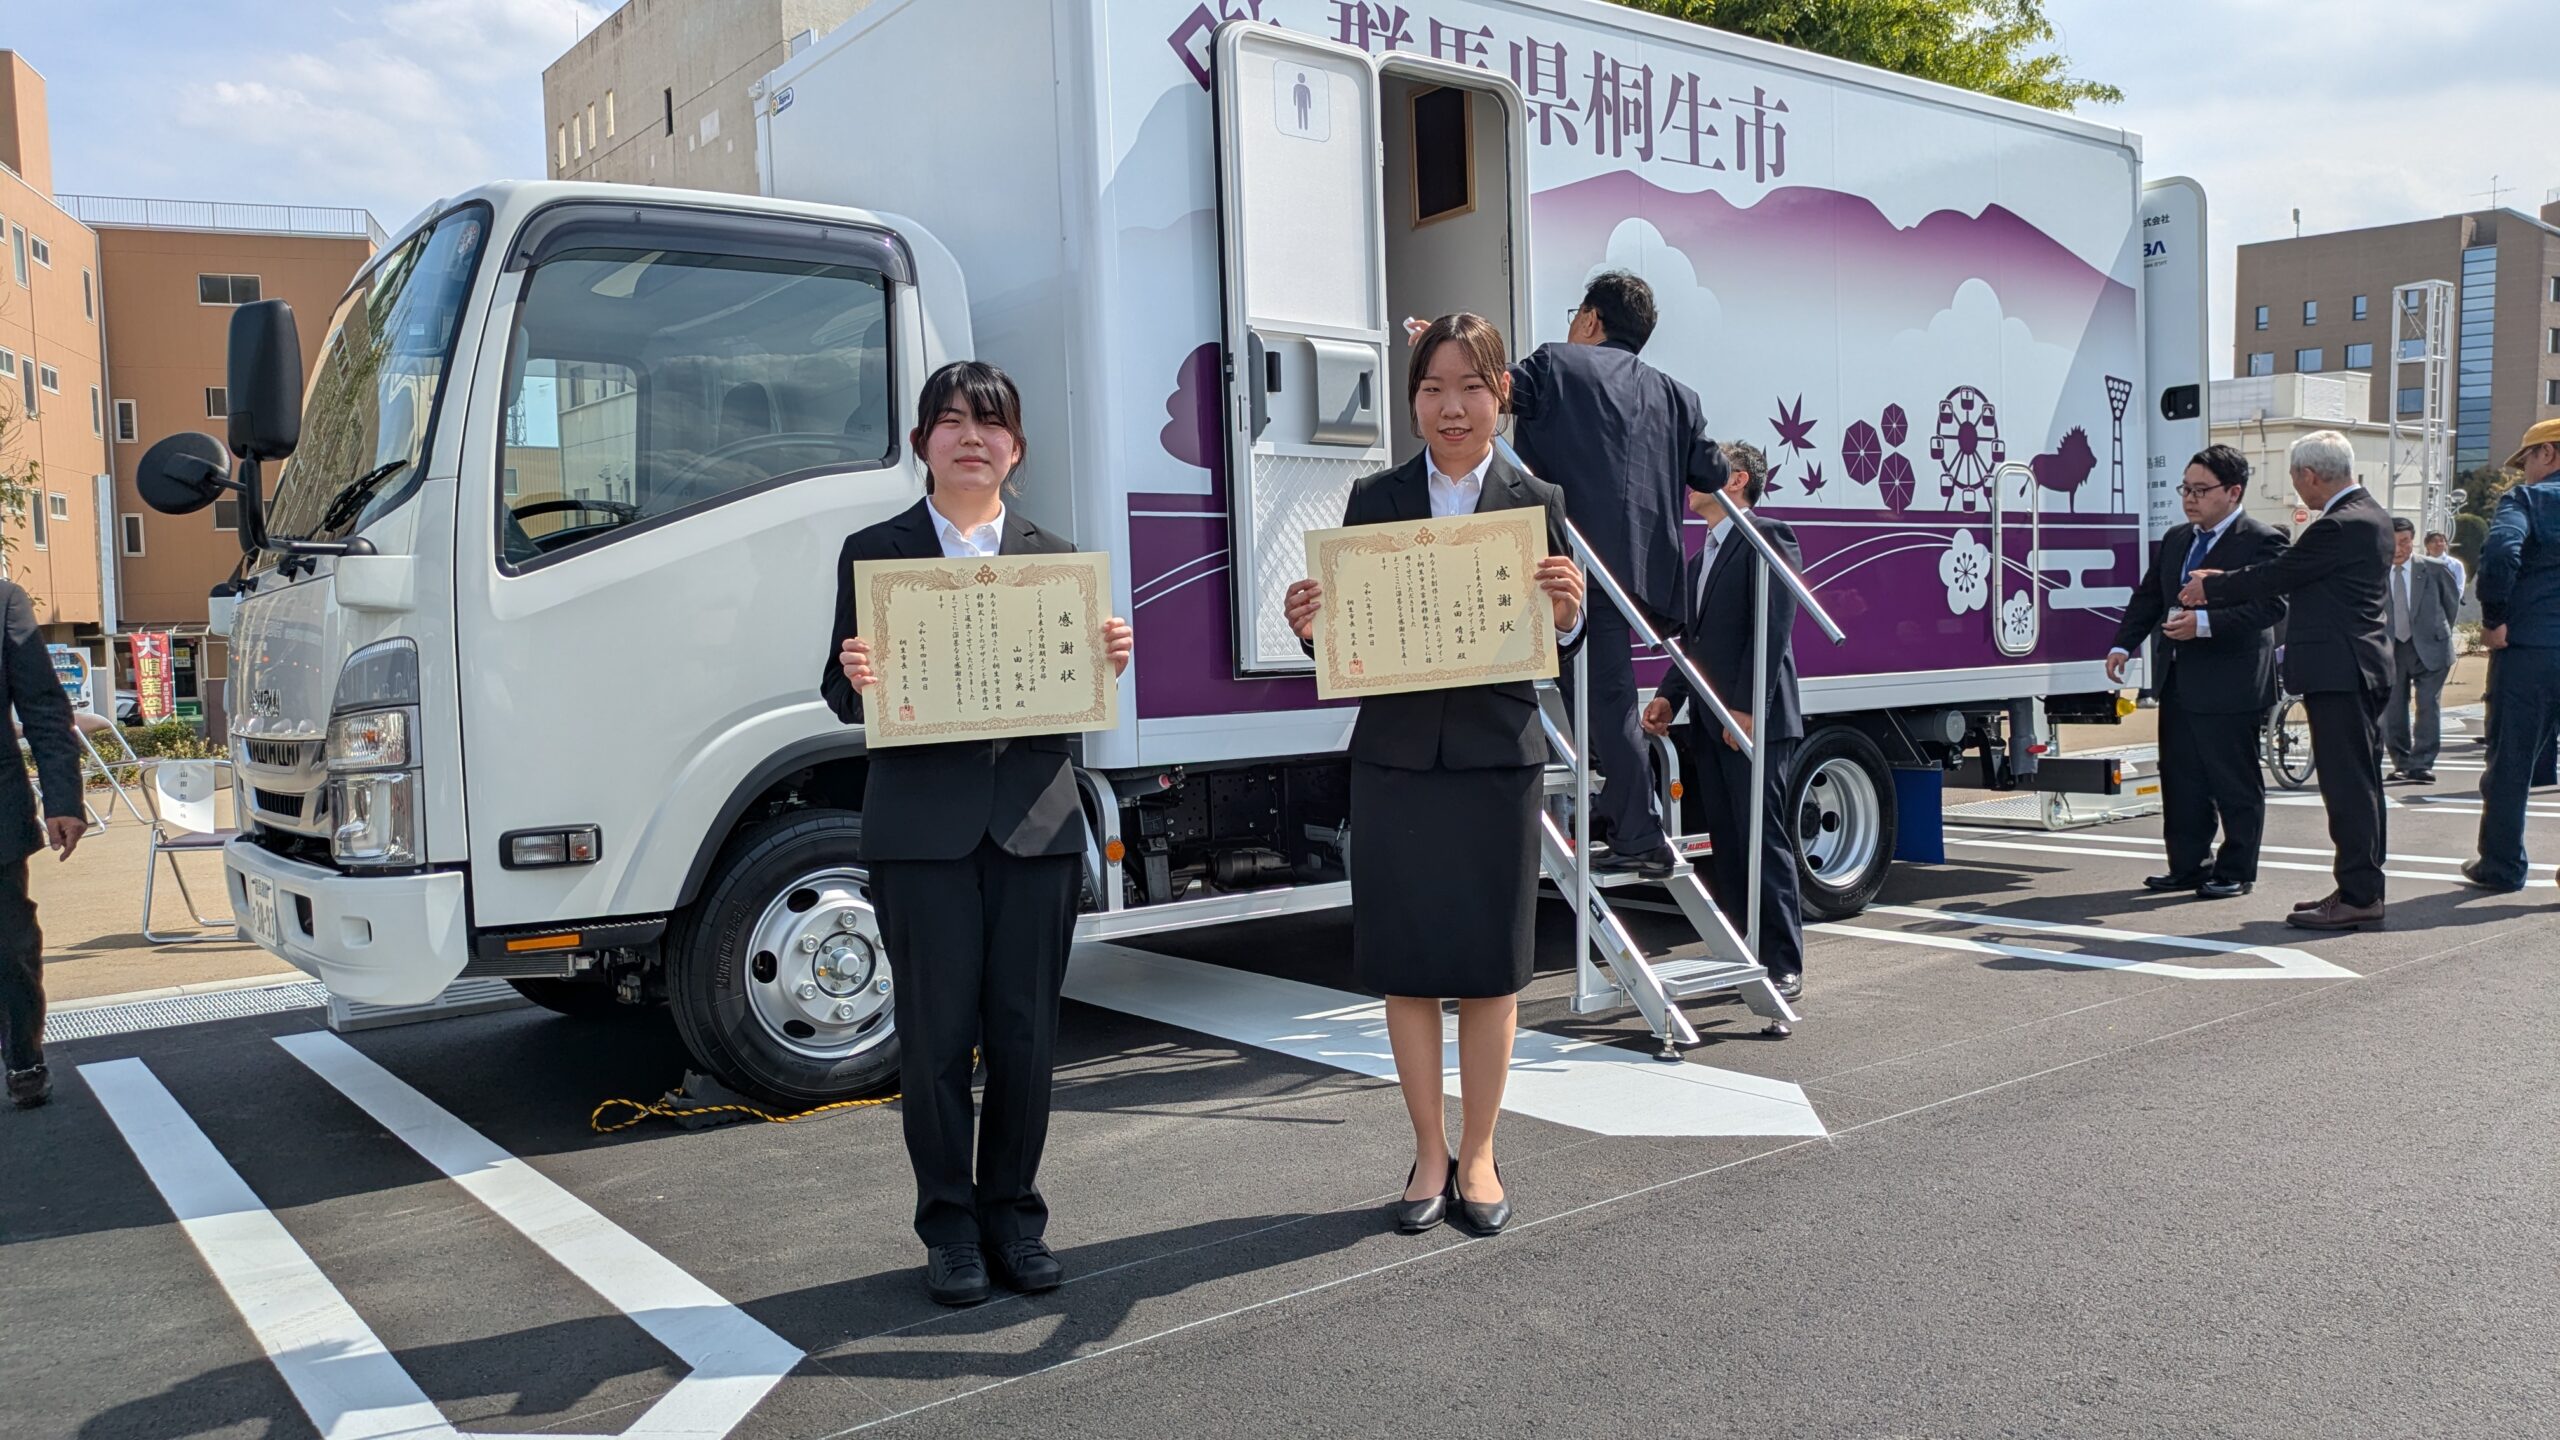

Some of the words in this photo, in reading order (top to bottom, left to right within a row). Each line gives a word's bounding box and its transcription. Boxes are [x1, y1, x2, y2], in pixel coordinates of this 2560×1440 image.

[1452, 600, 1463, 618] 石田
[1494, 565, 1516, 635] 感謝状
[1012, 645, 1023, 664] 山田
[1057, 610, 1077, 684] 感謝状
